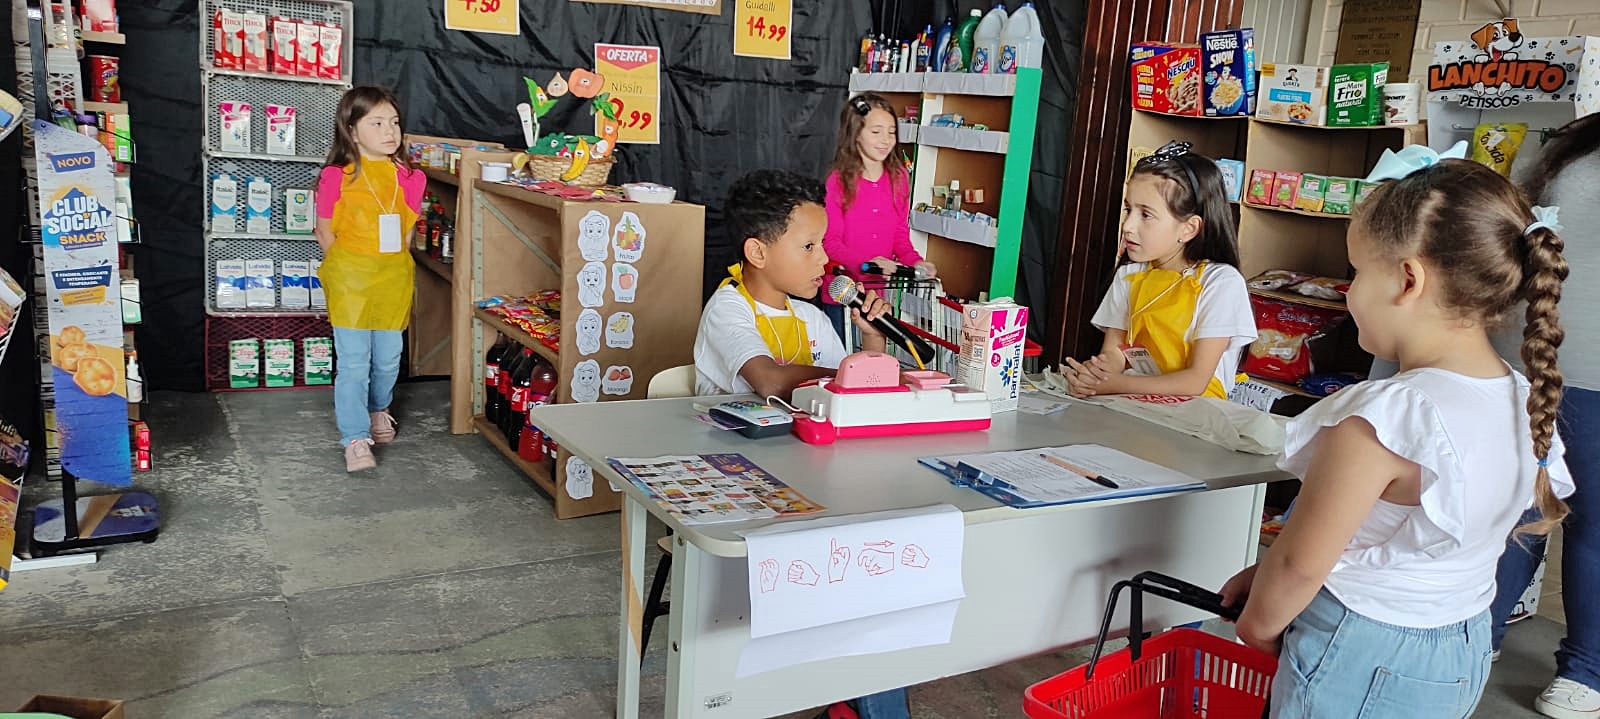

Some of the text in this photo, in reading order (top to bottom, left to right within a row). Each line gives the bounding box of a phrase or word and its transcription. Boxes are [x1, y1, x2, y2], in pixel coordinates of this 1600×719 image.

[746, 15, 786, 42] 14,99
[606, 48, 649, 63] OFERTA
[1210, 50, 1235, 69] SNOW
[1167, 57, 1195, 80] NESCAU
[1428, 61, 1566, 92] LANCHITO
[611, 81, 643, 94] Nissin
[1337, 87, 1362, 100] Frio
[1459, 94, 1520, 108] PETISCOS
[56, 155, 91, 168] NOVO
[52, 195, 99, 217] CLUB
[48, 209, 112, 234] SOCIAL
[59, 231, 107, 245] SNACK
[1010, 343, 1022, 399] parmalat
